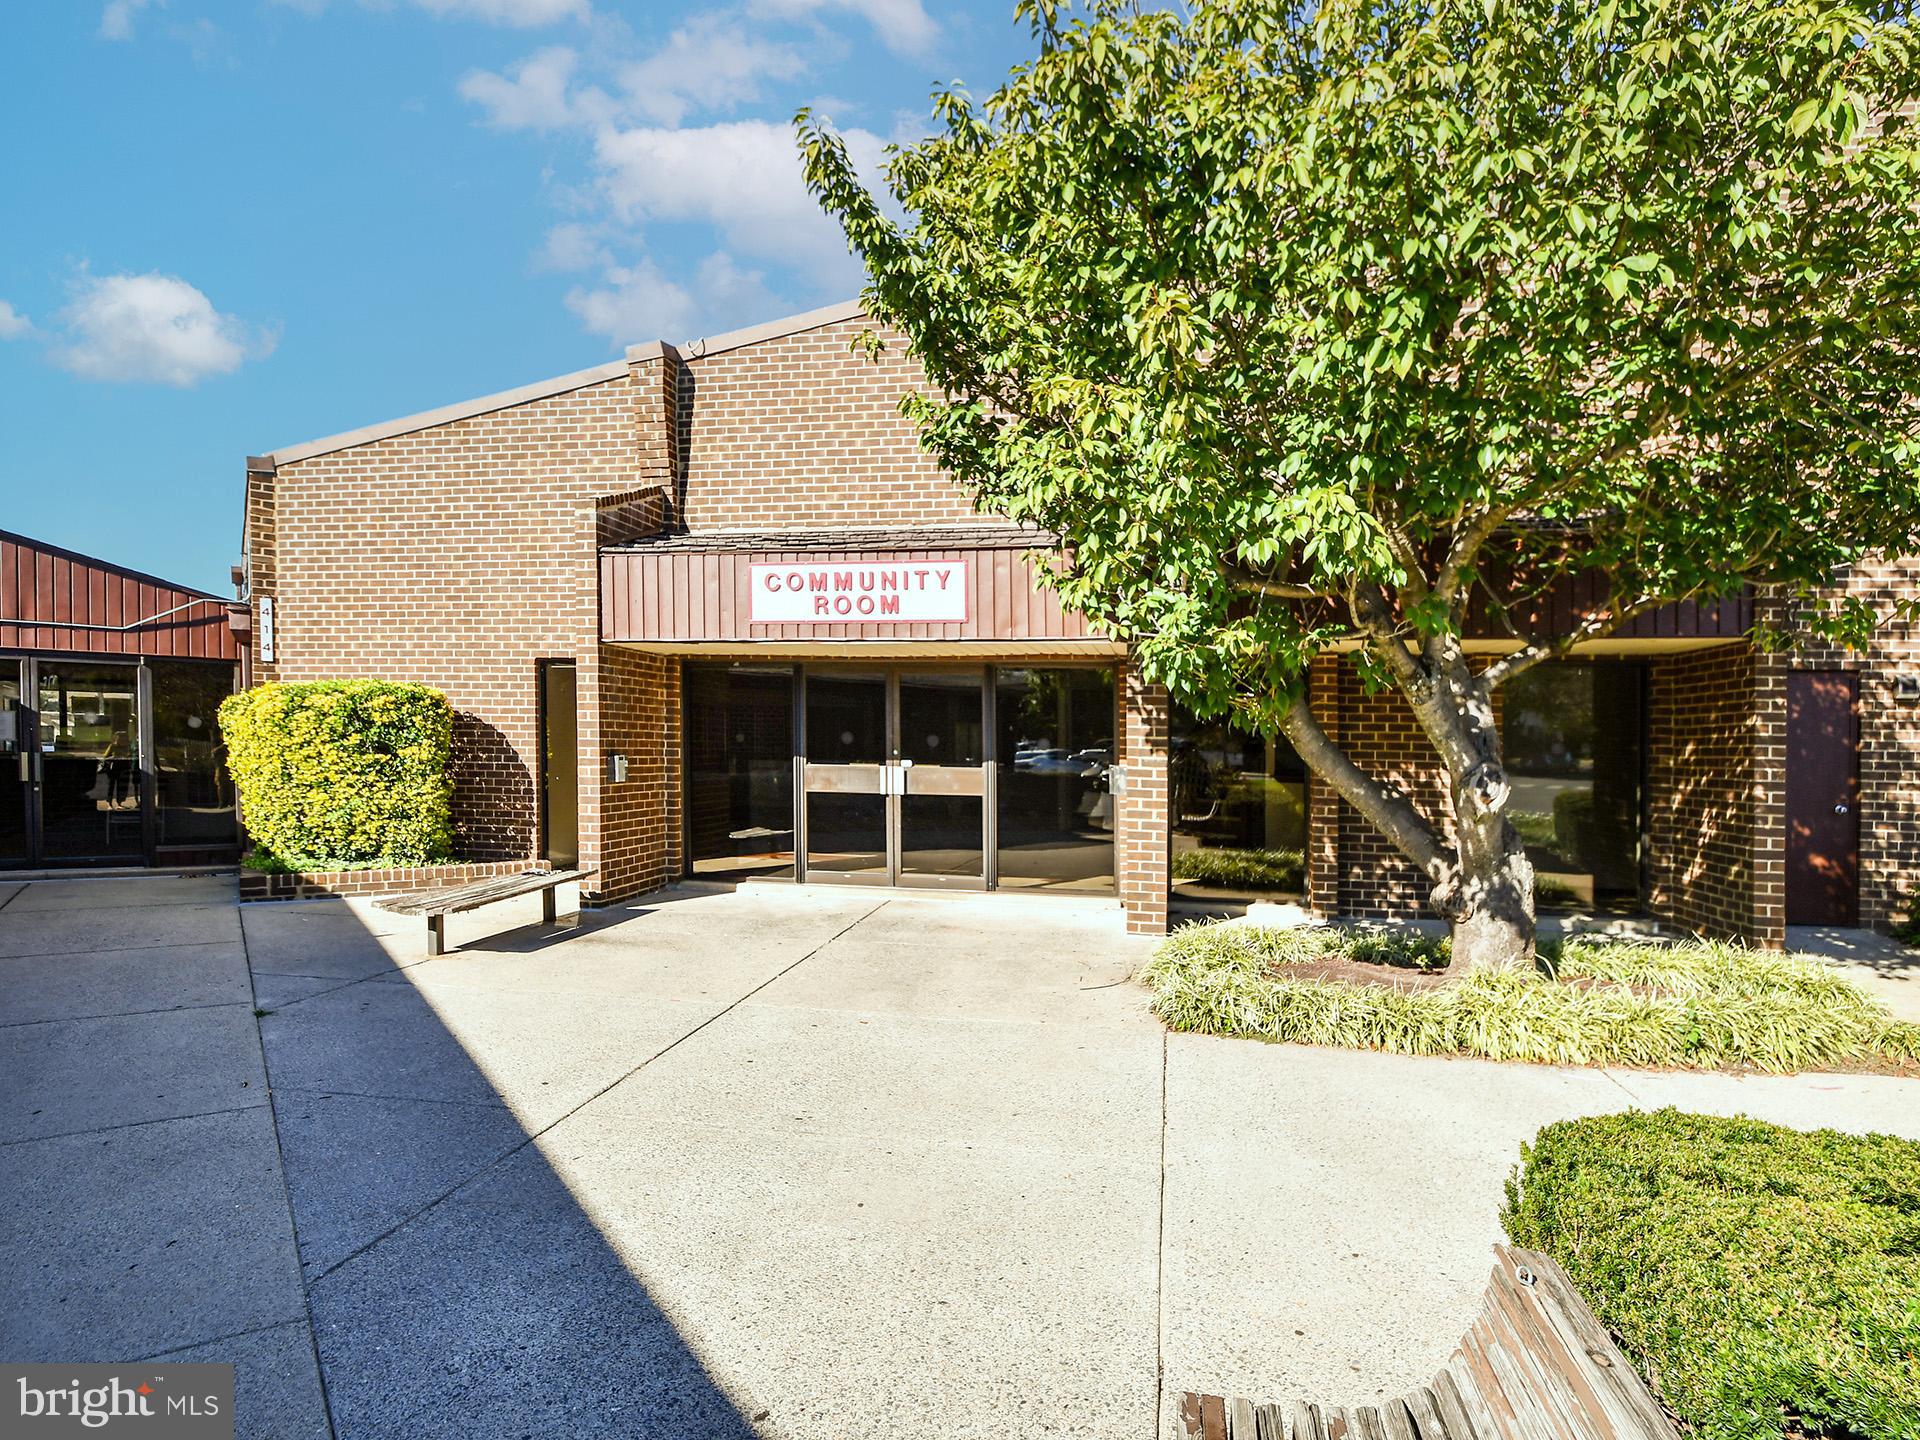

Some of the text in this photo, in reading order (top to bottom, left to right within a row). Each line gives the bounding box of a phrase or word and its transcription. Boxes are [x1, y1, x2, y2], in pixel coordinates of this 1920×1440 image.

[764, 570, 951, 592] COMMUNITY
[814, 595, 899, 615] ROOM
[261, 607, 271, 651] 414
